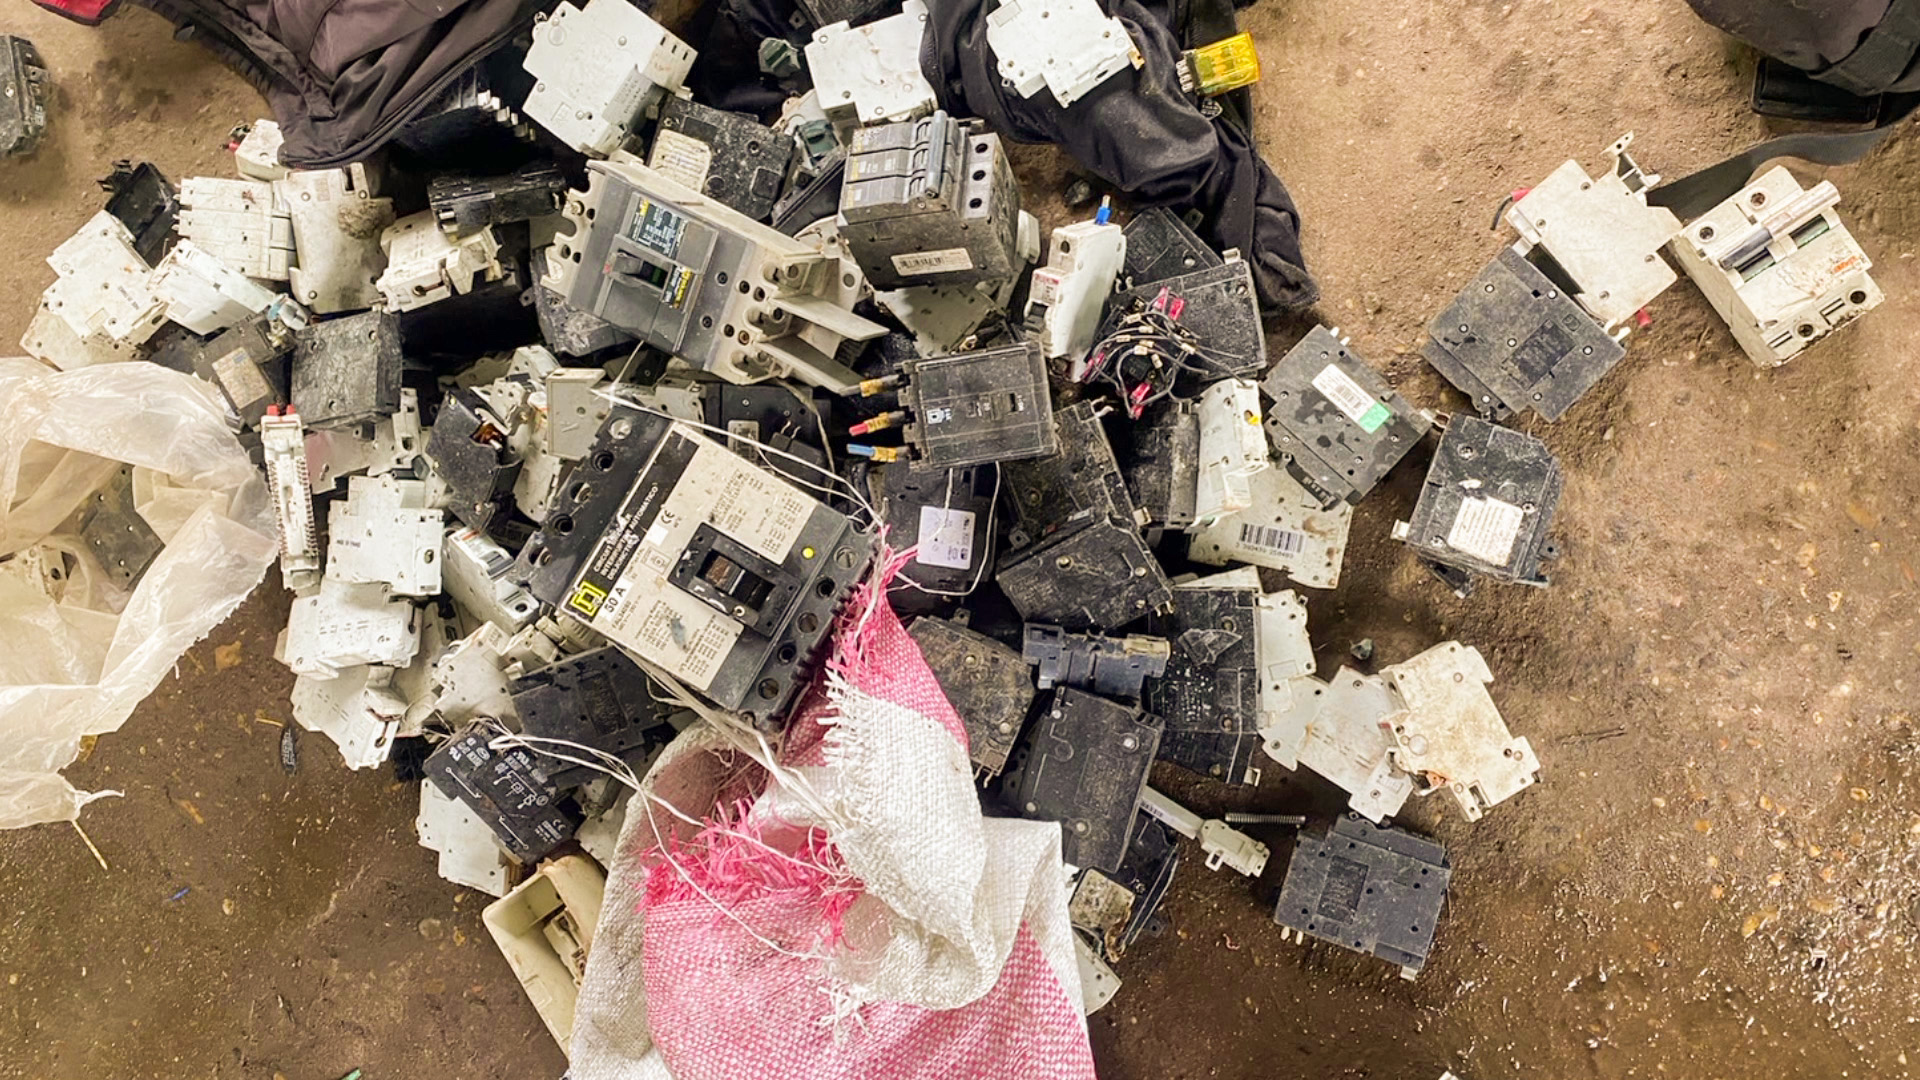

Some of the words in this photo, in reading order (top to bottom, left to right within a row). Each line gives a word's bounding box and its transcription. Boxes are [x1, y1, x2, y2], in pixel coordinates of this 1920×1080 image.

[627, 485, 658, 530] AUTOMATICO
[592, 543, 613, 572] CIRCUIT
[615, 586, 626, 598] A
